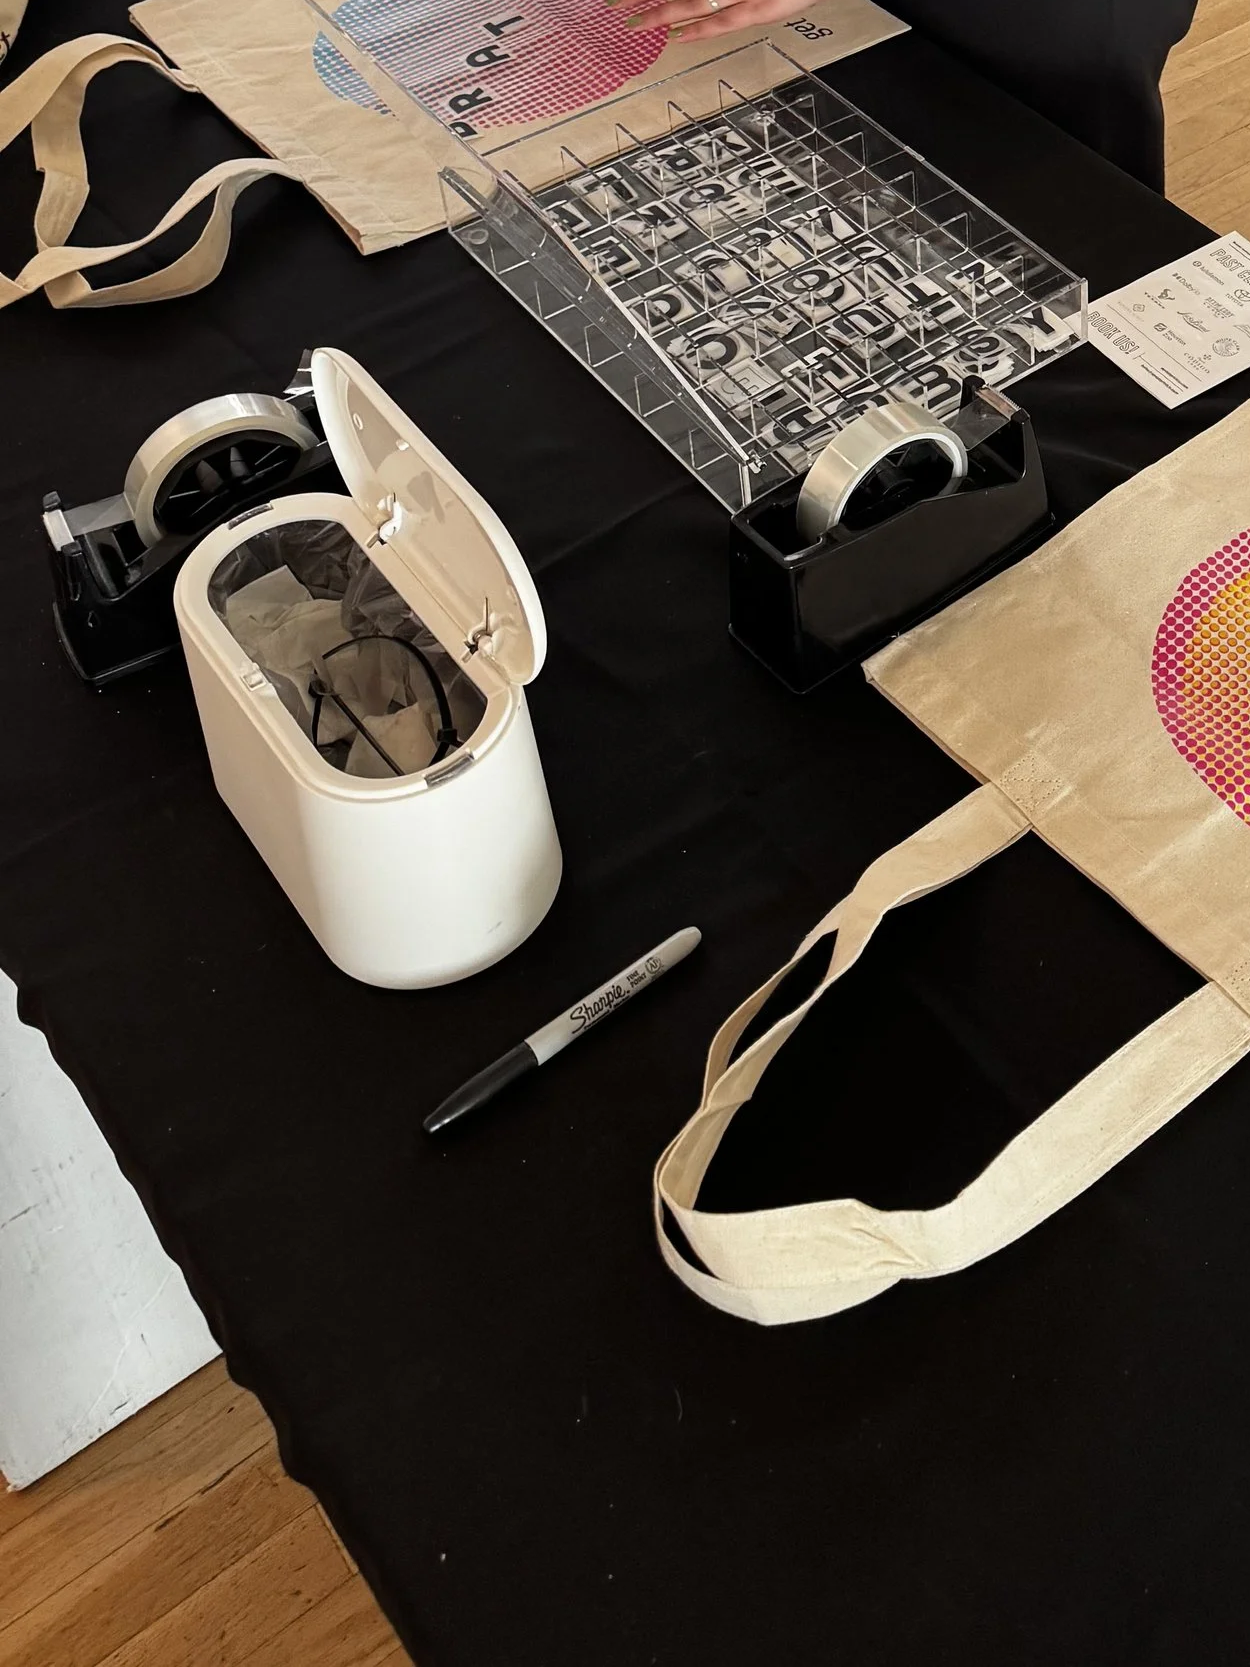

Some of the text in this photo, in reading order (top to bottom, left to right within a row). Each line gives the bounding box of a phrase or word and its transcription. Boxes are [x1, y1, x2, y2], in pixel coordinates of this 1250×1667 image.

[783, 17, 833, 40] get
[1210, 248, 1245, 272] PAST
[1087, 311, 1121, 340] BOOK
[1113, 334, 1140, 355] US!
[570, 985, 626, 1035] Sharpie
